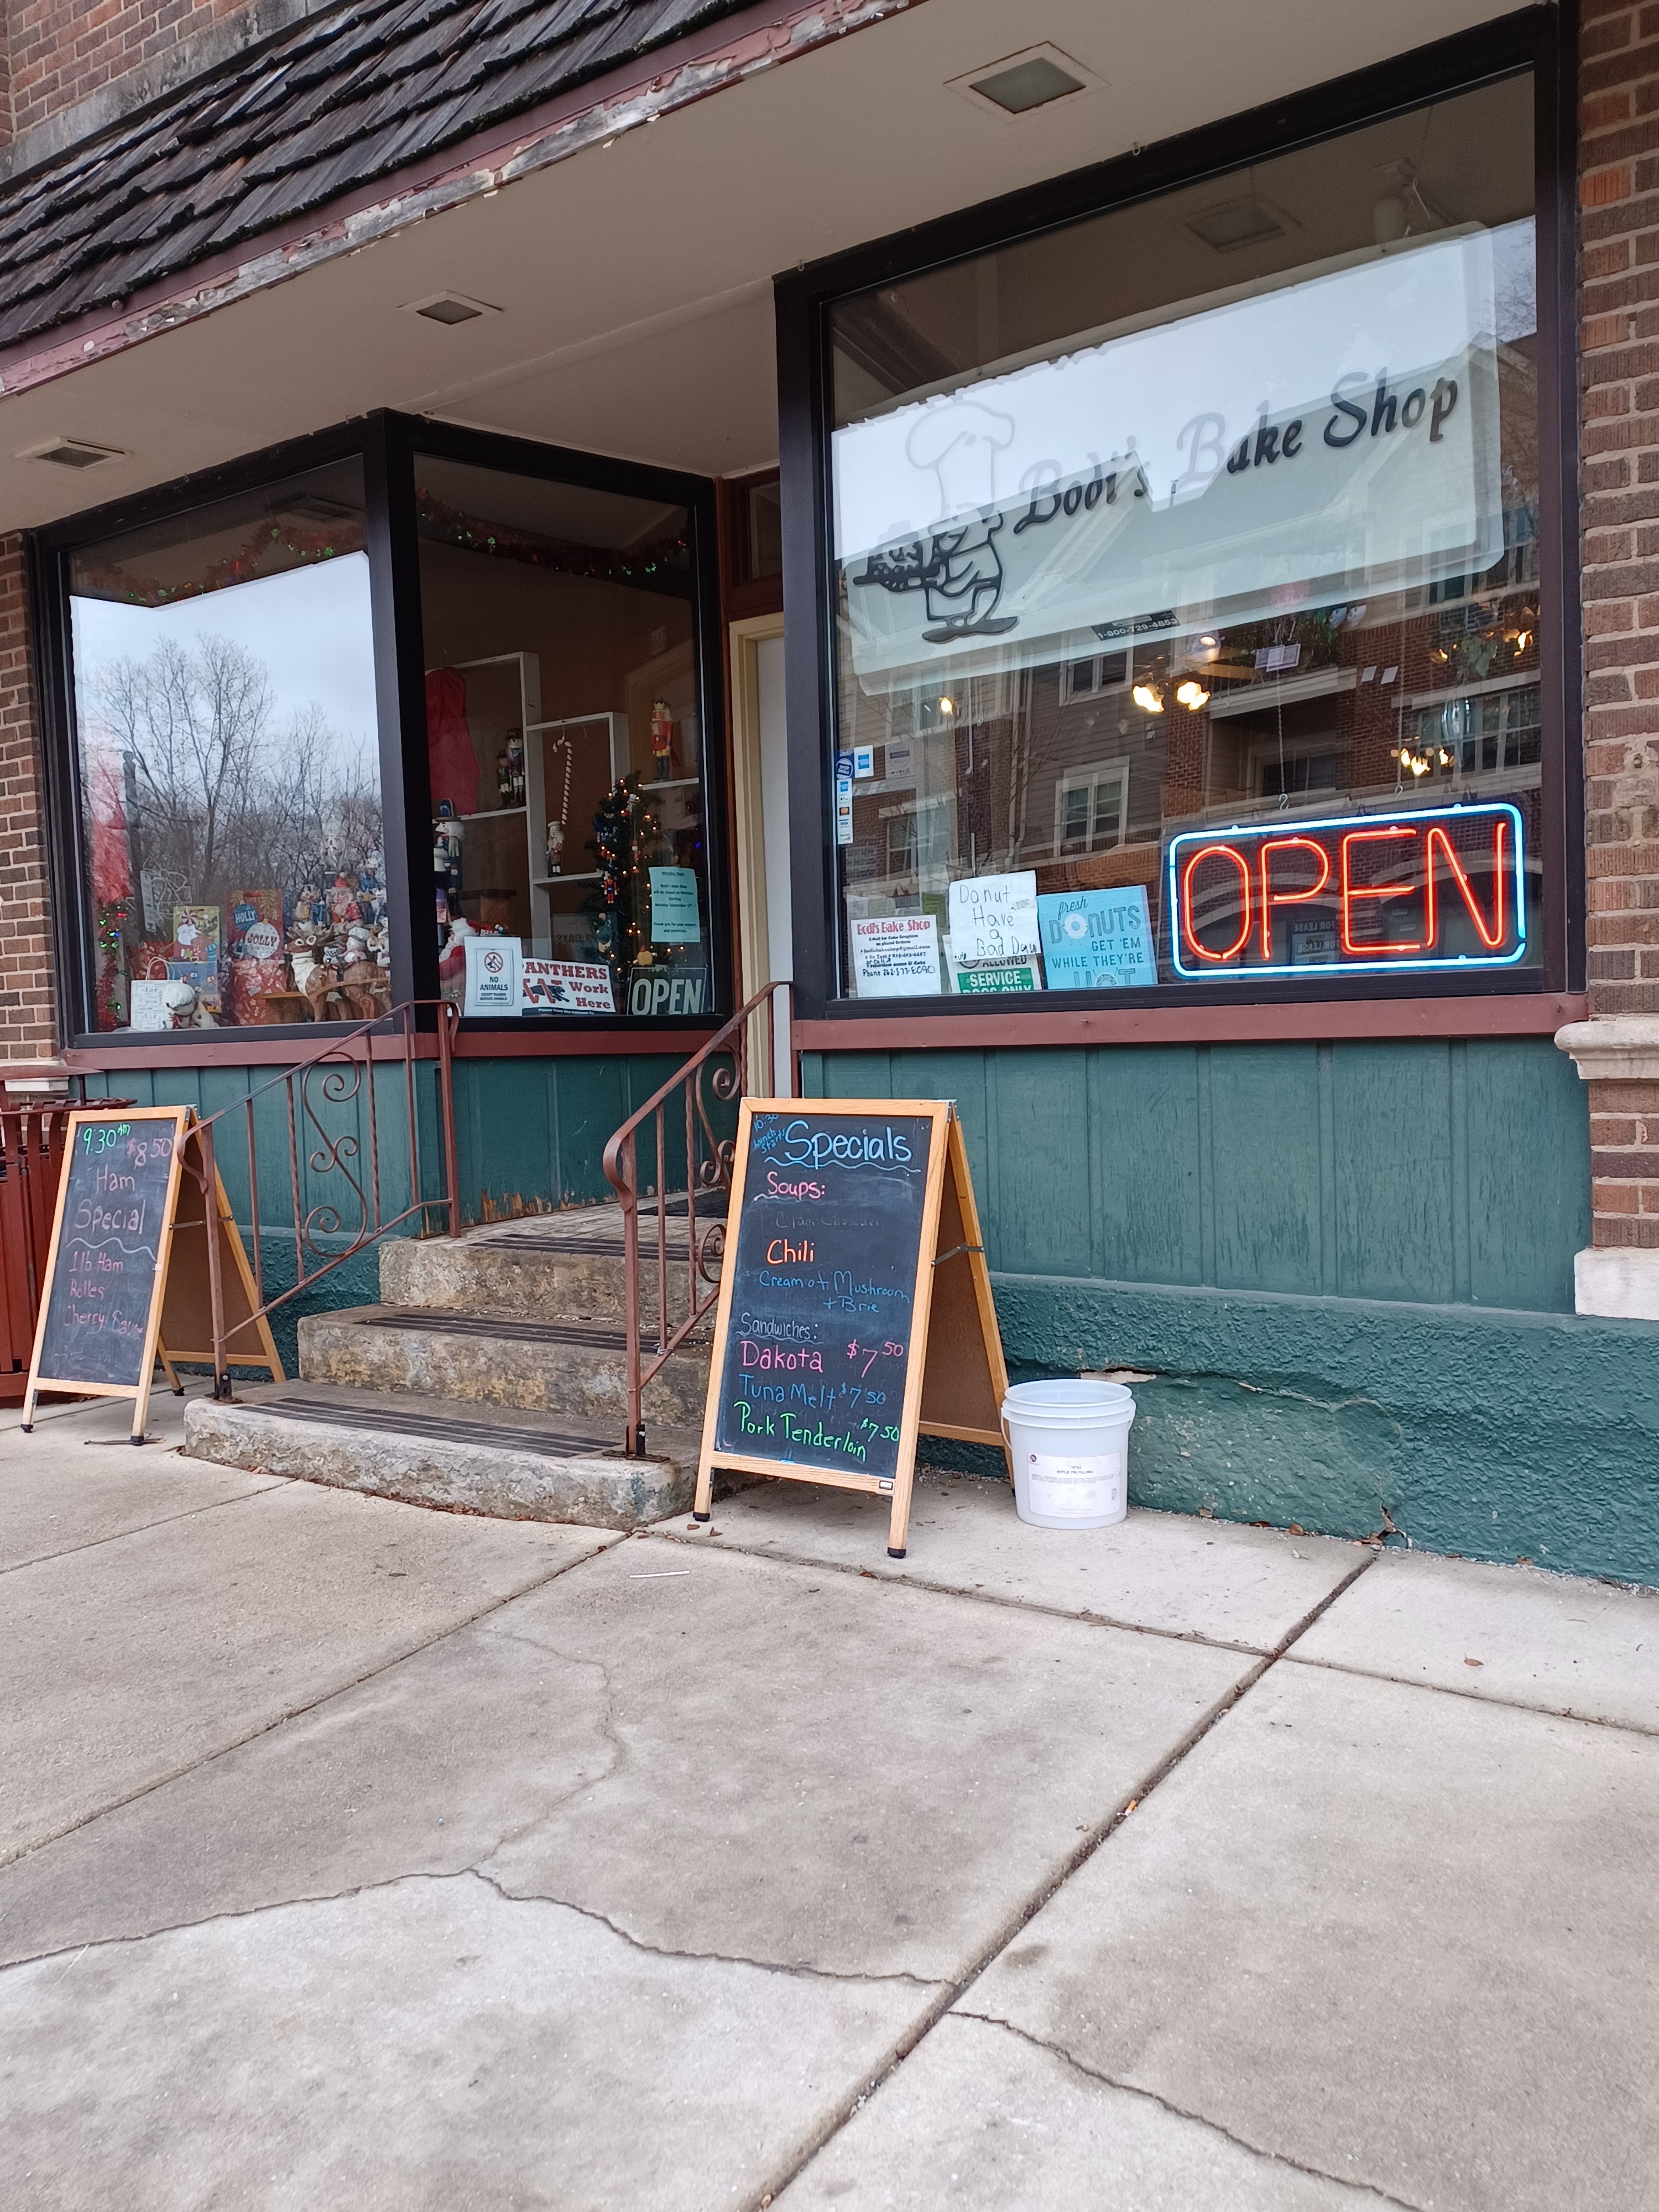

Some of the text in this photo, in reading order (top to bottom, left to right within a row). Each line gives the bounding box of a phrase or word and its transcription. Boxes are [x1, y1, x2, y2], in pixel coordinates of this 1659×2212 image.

[1013, 367, 1458, 534] Bodi's Bake Shop
[1097, 618, 1178, 639] 1-800-729-4853
[959, 884, 1010, 904] Donut
[1183, 822, 1507, 960] OPEN
[234, 910, 255, 924] HOLLY
[973, 905, 1015, 927] Have
[1058, 896, 1089, 921] fresh
[881, 921, 904, 933] Bake
[907, 920, 931, 931] Shop
[989, 928, 1003, 940] a
[1049, 905, 1141, 944] DONUTS
[247, 933, 278, 947] JOLLY
[977, 938, 1005, 956] Bad
[1092, 937, 1141, 951] GET 'EM
[522, 962, 608, 980] ANTHERS
[1052, 952, 1144, 968] WHILE THEY'RE
[568, 981, 609, 994] Work
[969, 971, 1022, 987] SERVICE
[576, 997, 611, 1009] Here
[632, 978, 702, 1015] OPEN
[754, 1113, 779, 1132] 10:30
[84, 1128, 117, 1155] 9:30
[753, 1127, 776, 1149] Lunch
[761, 1128, 786, 1154] Starts
[784, 1119, 912, 1170] Specials
[95, 1164, 135, 1194] Ham
[766, 1171, 826, 1199] Soups:
[74, 1198, 146, 1235] Special
[97, 1251, 124, 1272] Ham
[766, 1239, 815, 1265] Chili
[759, 1270, 804, 1288] Cream
[833, 1270, 910, 1304] Mushroom
[837, 1295, 880, 1313] Brie
[740, 1312, 819, 1339] Sandwiches:
[740, 1340, 823, 1374] Dakota
[738, 1374, 785, 1403] Tuna
[790, 1383, 837, 1411] Melt
[733, 1400, 775, 1437] Pork
[779, 1412, 867, 1463] Tenderloin
